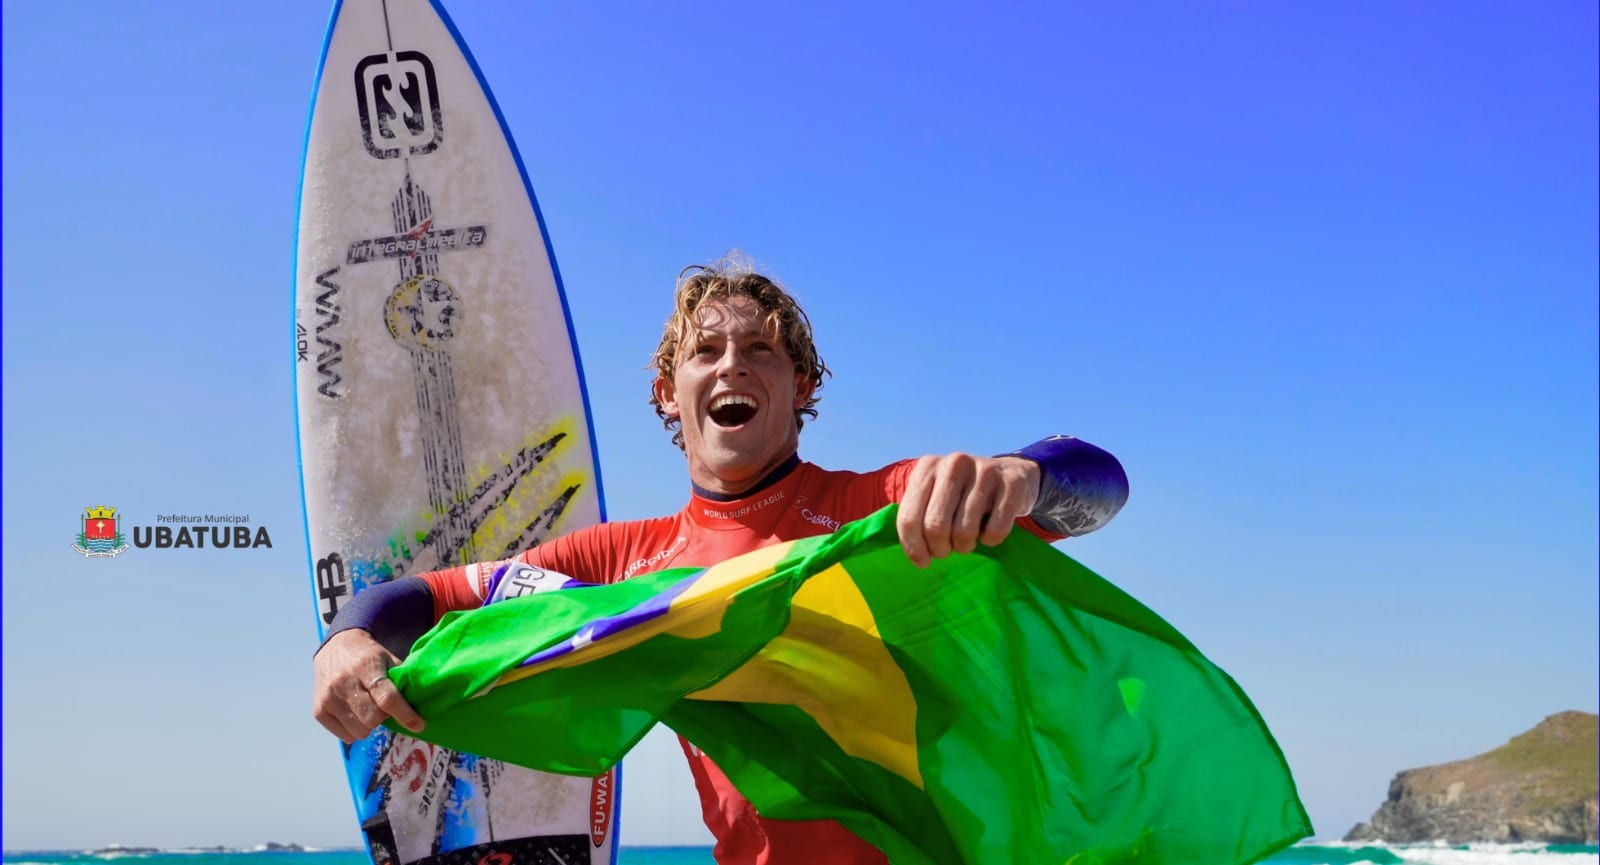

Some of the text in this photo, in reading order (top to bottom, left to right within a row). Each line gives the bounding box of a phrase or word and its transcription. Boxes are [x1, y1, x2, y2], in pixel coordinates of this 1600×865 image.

[297, 322, 308, 363] ALOK
[703, 490, 785, 519] WORLD SURF LEAGUE
